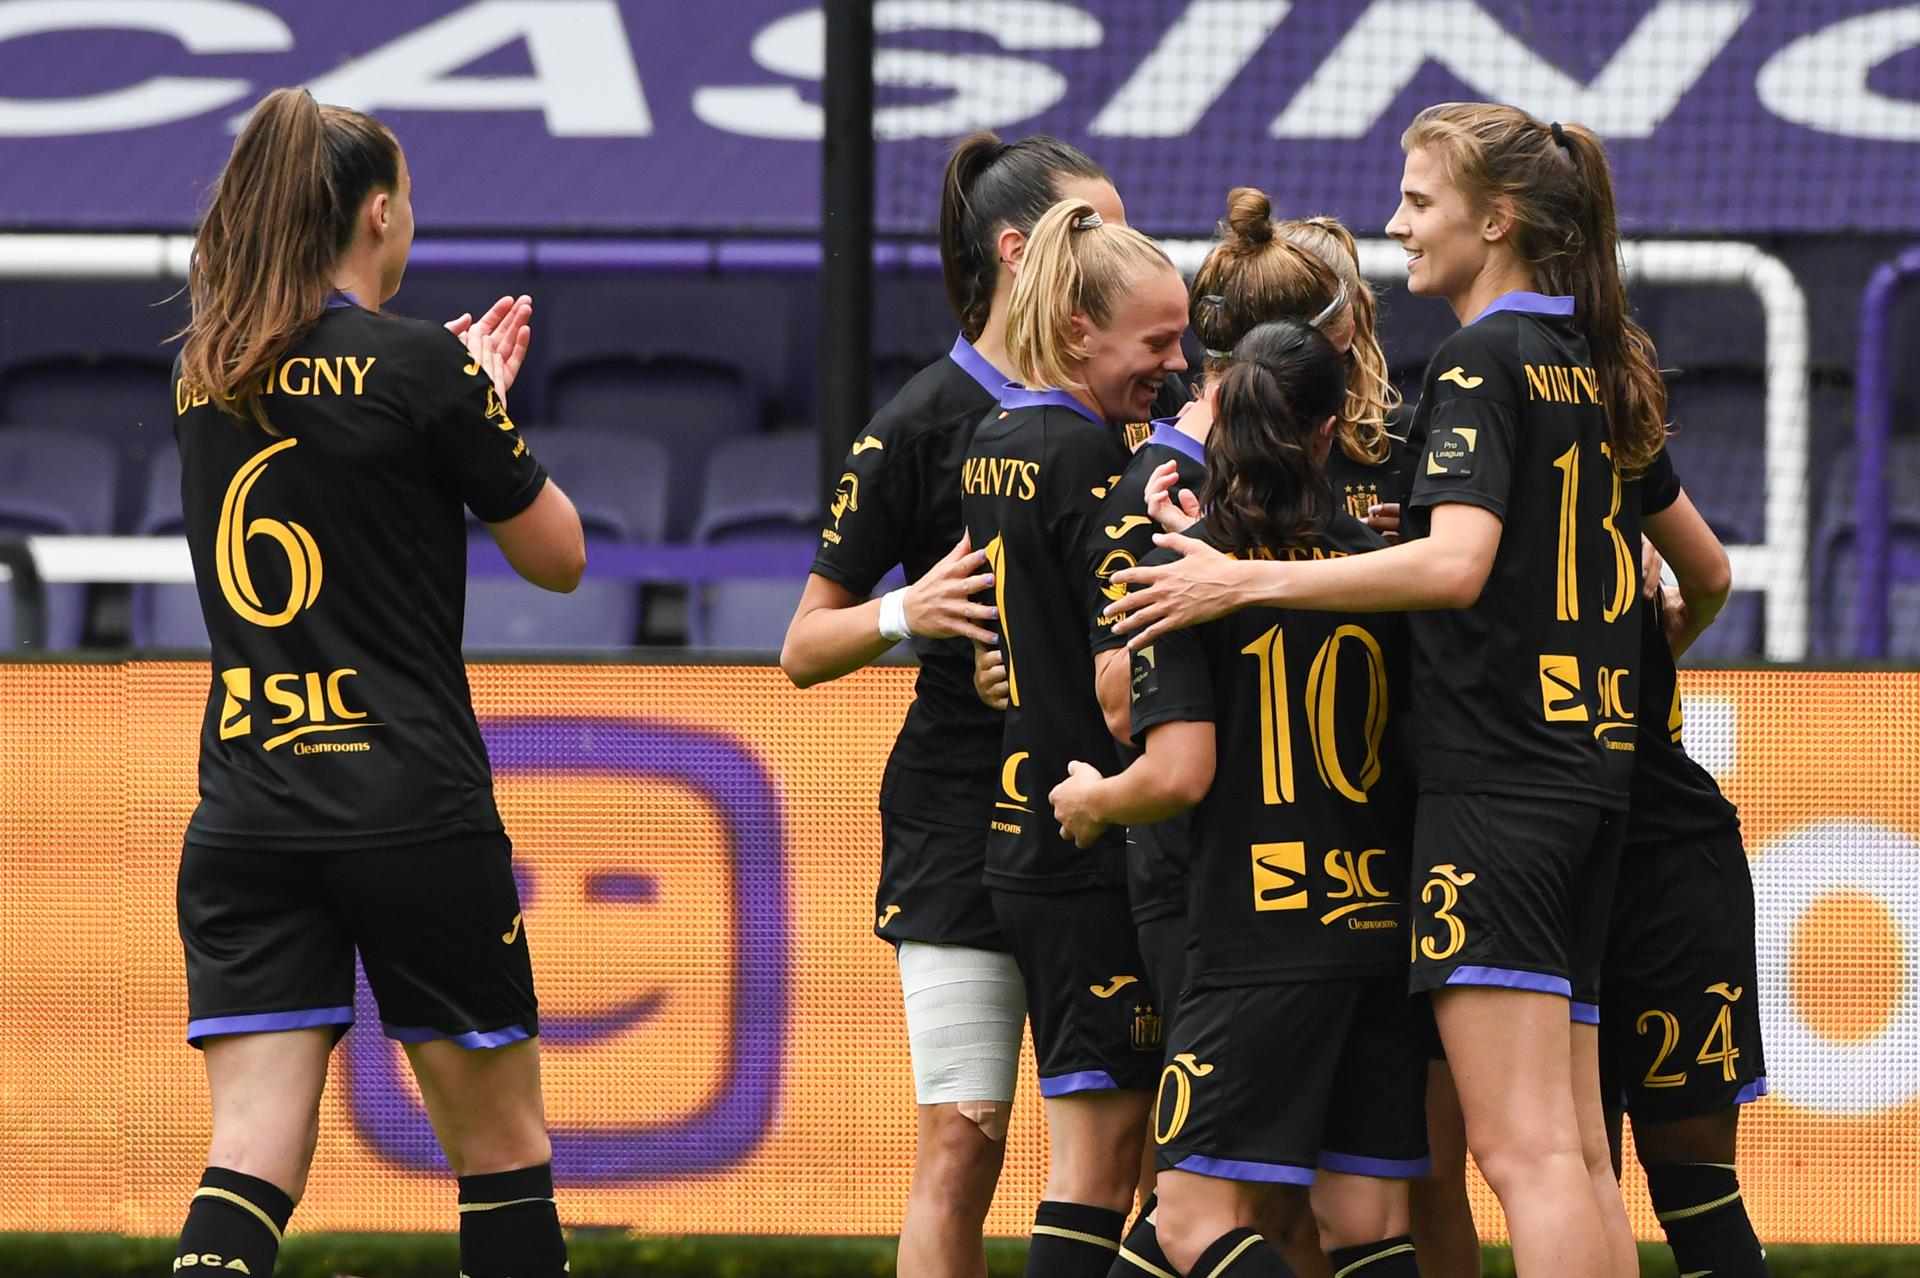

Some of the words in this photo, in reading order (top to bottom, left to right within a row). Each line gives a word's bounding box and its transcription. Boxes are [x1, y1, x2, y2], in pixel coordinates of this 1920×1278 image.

[224, 357, 377, 400] IGNY
[1435, 450, 1465, 459] League
[1443, 441, 1458, 449] Pro
[216, 437, 323, 628] 6
[1553, 441, 1636, 623] 13
[264, 669, 368, 725] SIC
[1241, 623, 1389, 805] 10
[294, 741, 371, 756] Cleanrooms
[1323, 849, 1390, 898] SIC
[1347, 917, 1398, 930] Cleanrooms
[1636, 1004, 1740, 1088] 24
